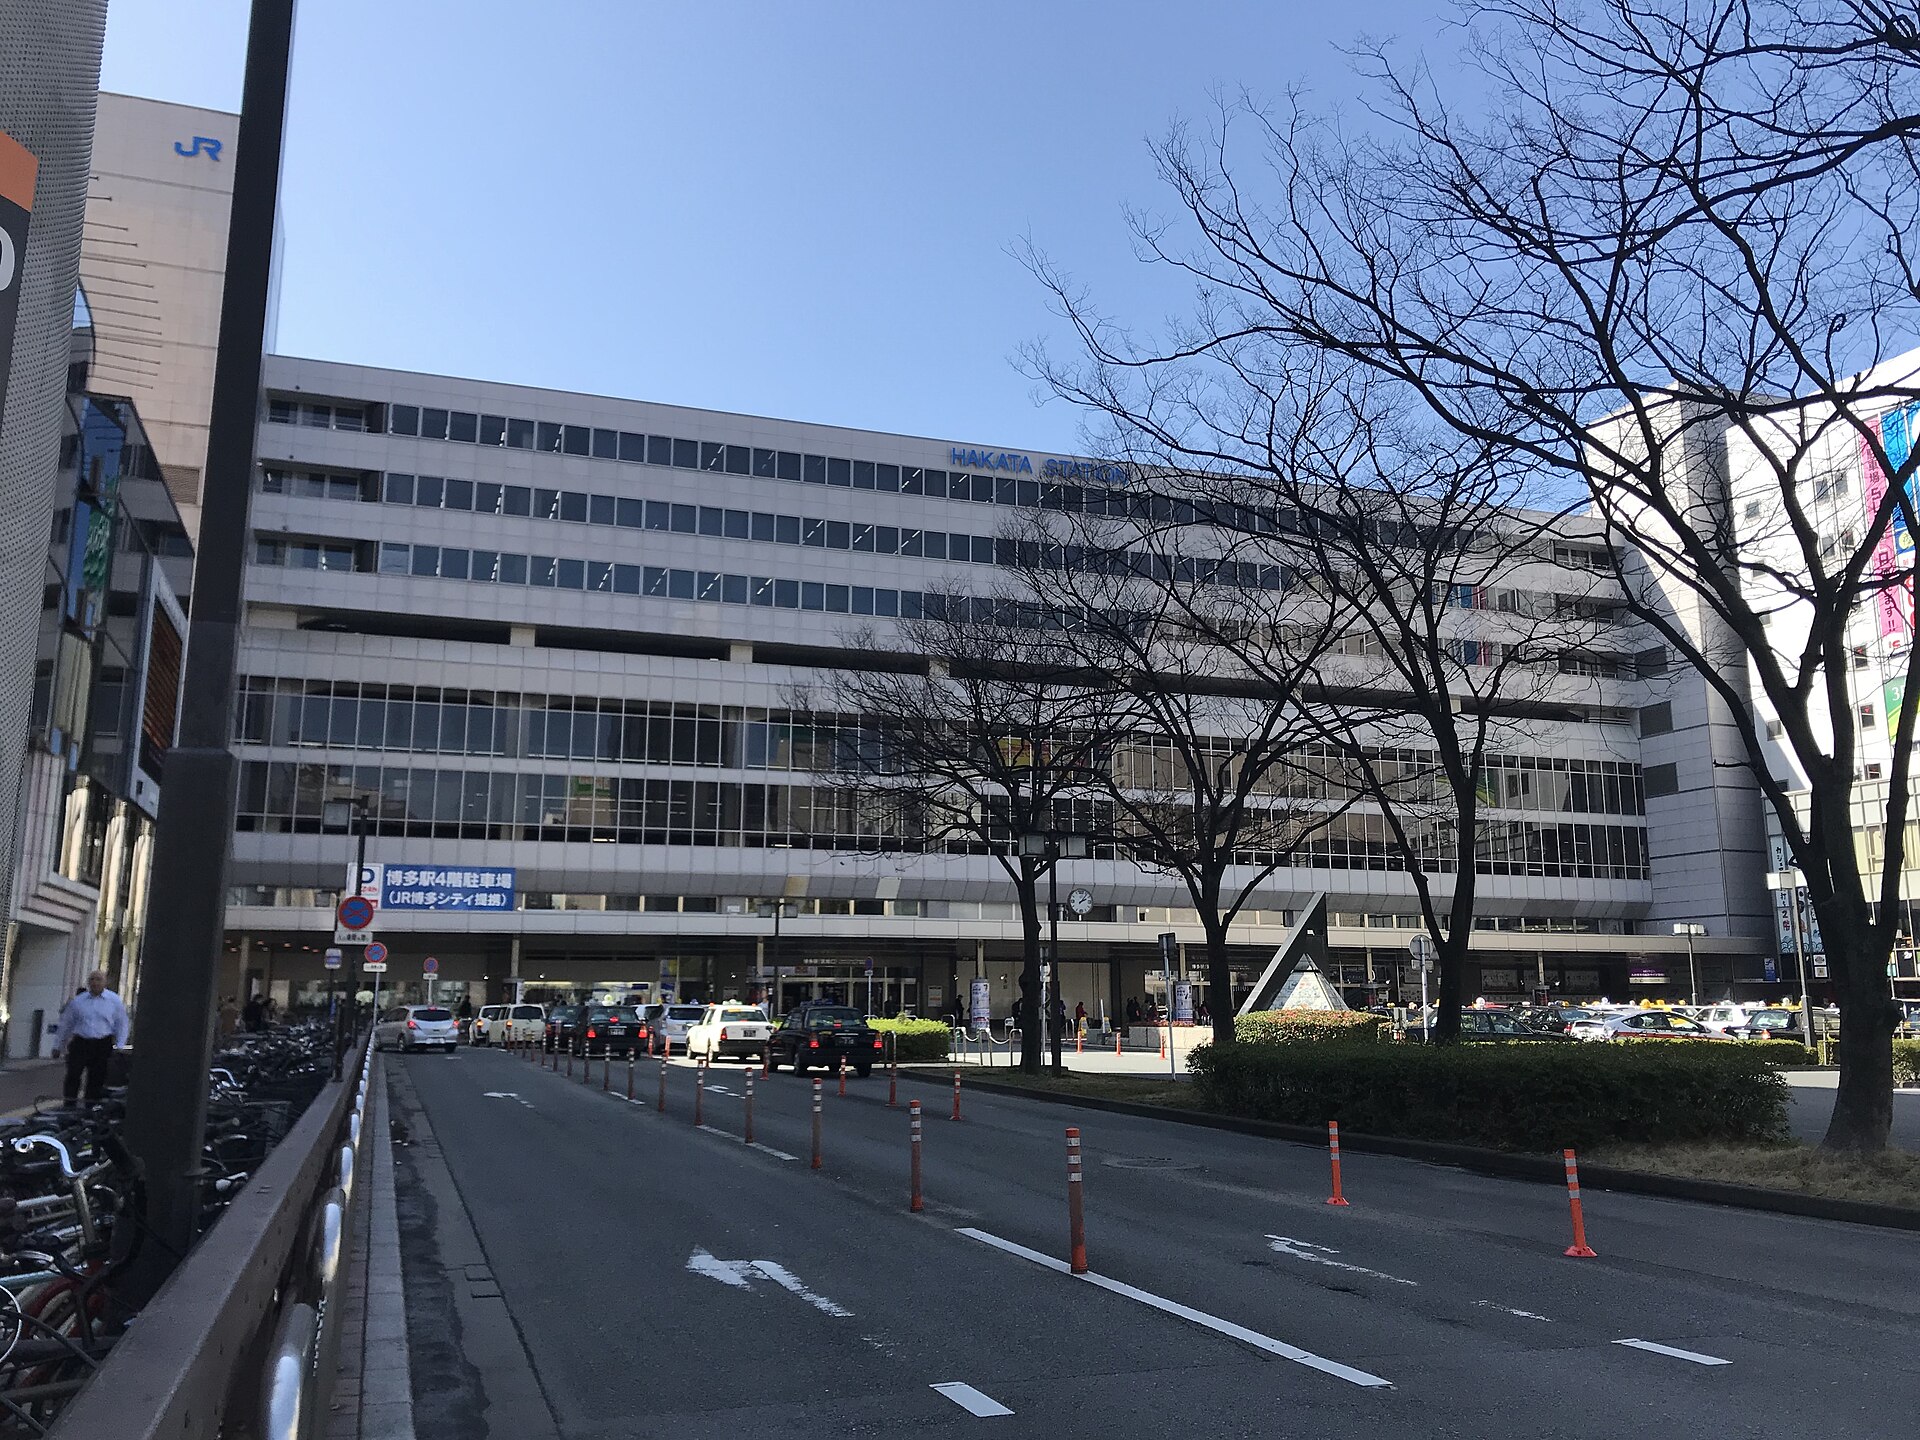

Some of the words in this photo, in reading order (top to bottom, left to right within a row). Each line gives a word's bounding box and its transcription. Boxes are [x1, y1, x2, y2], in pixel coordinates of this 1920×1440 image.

[174, 136, 222, 162] JR
[952, 447, 1033, 474] HAKATA
[386, 870, 512, 889] 博多駅4階駐車場
